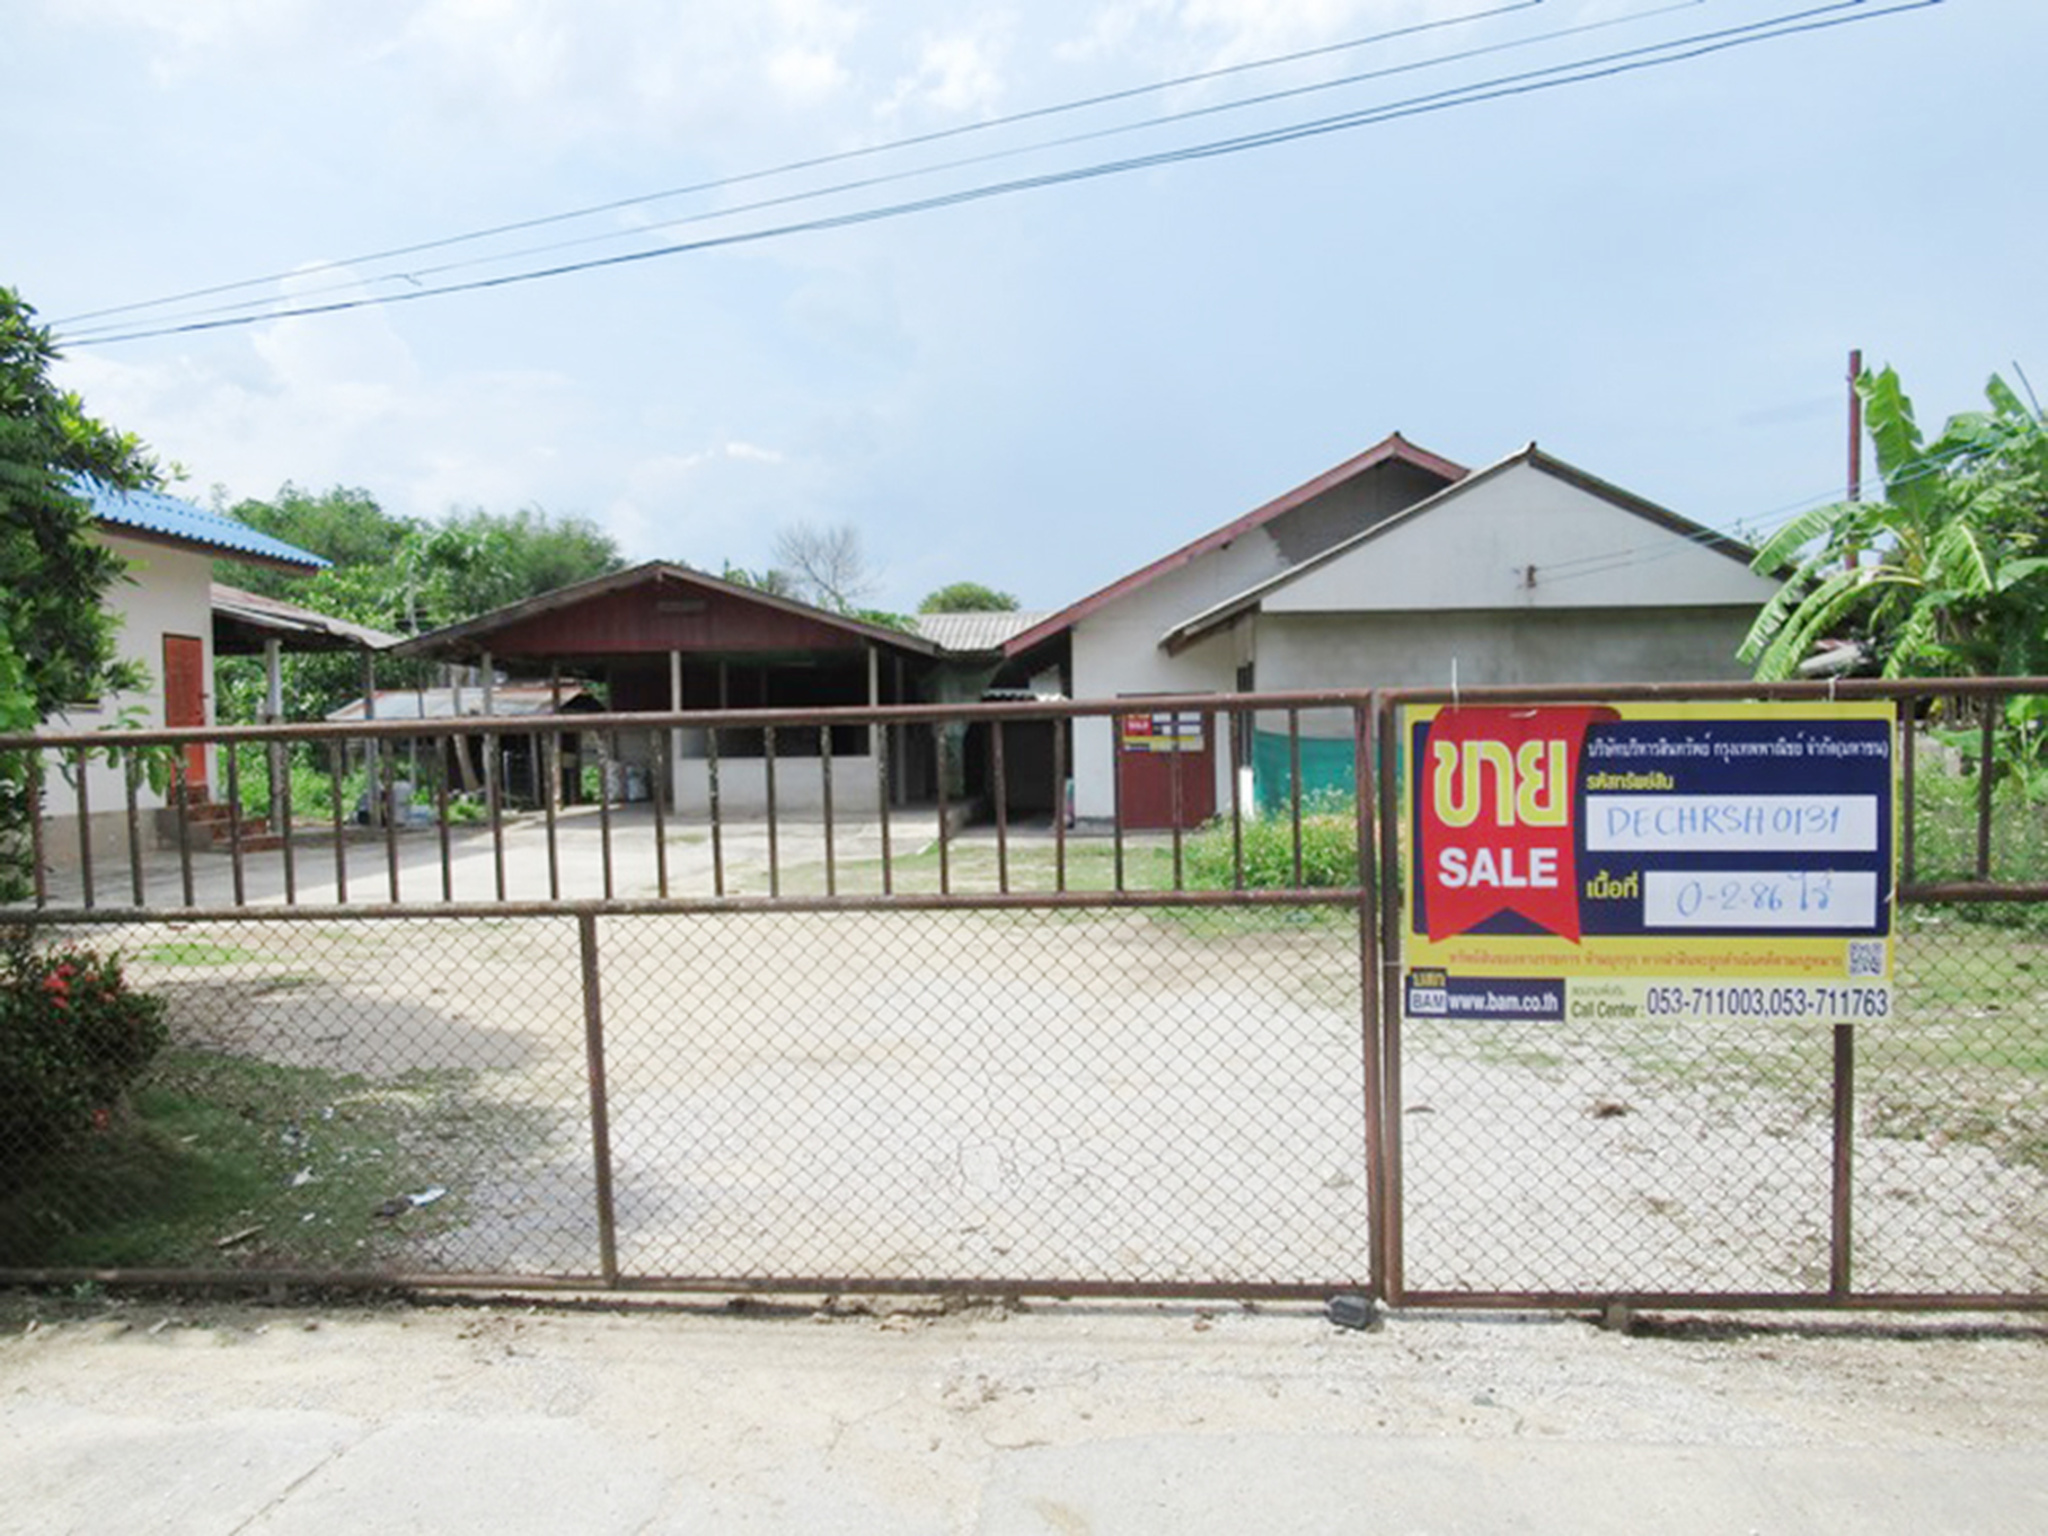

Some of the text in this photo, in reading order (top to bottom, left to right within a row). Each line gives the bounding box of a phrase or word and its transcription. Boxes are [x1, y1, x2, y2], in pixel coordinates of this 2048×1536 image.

[1433, 740, 1567, 828] ขาย
[1438, 848, 1558, 888] SALE
[1586, 871, 1638, 899] เนื้อที่
[1413, 993, 1446, 1009] BAM
[1449, 992, 1559, 1011] www.bam.co.th
[1571, 1000, 1595, 1018] Call
[1597, 1000, 1638, 1019] Center
[1646, 988, 1888, 1017] 053-711003,053-711763
